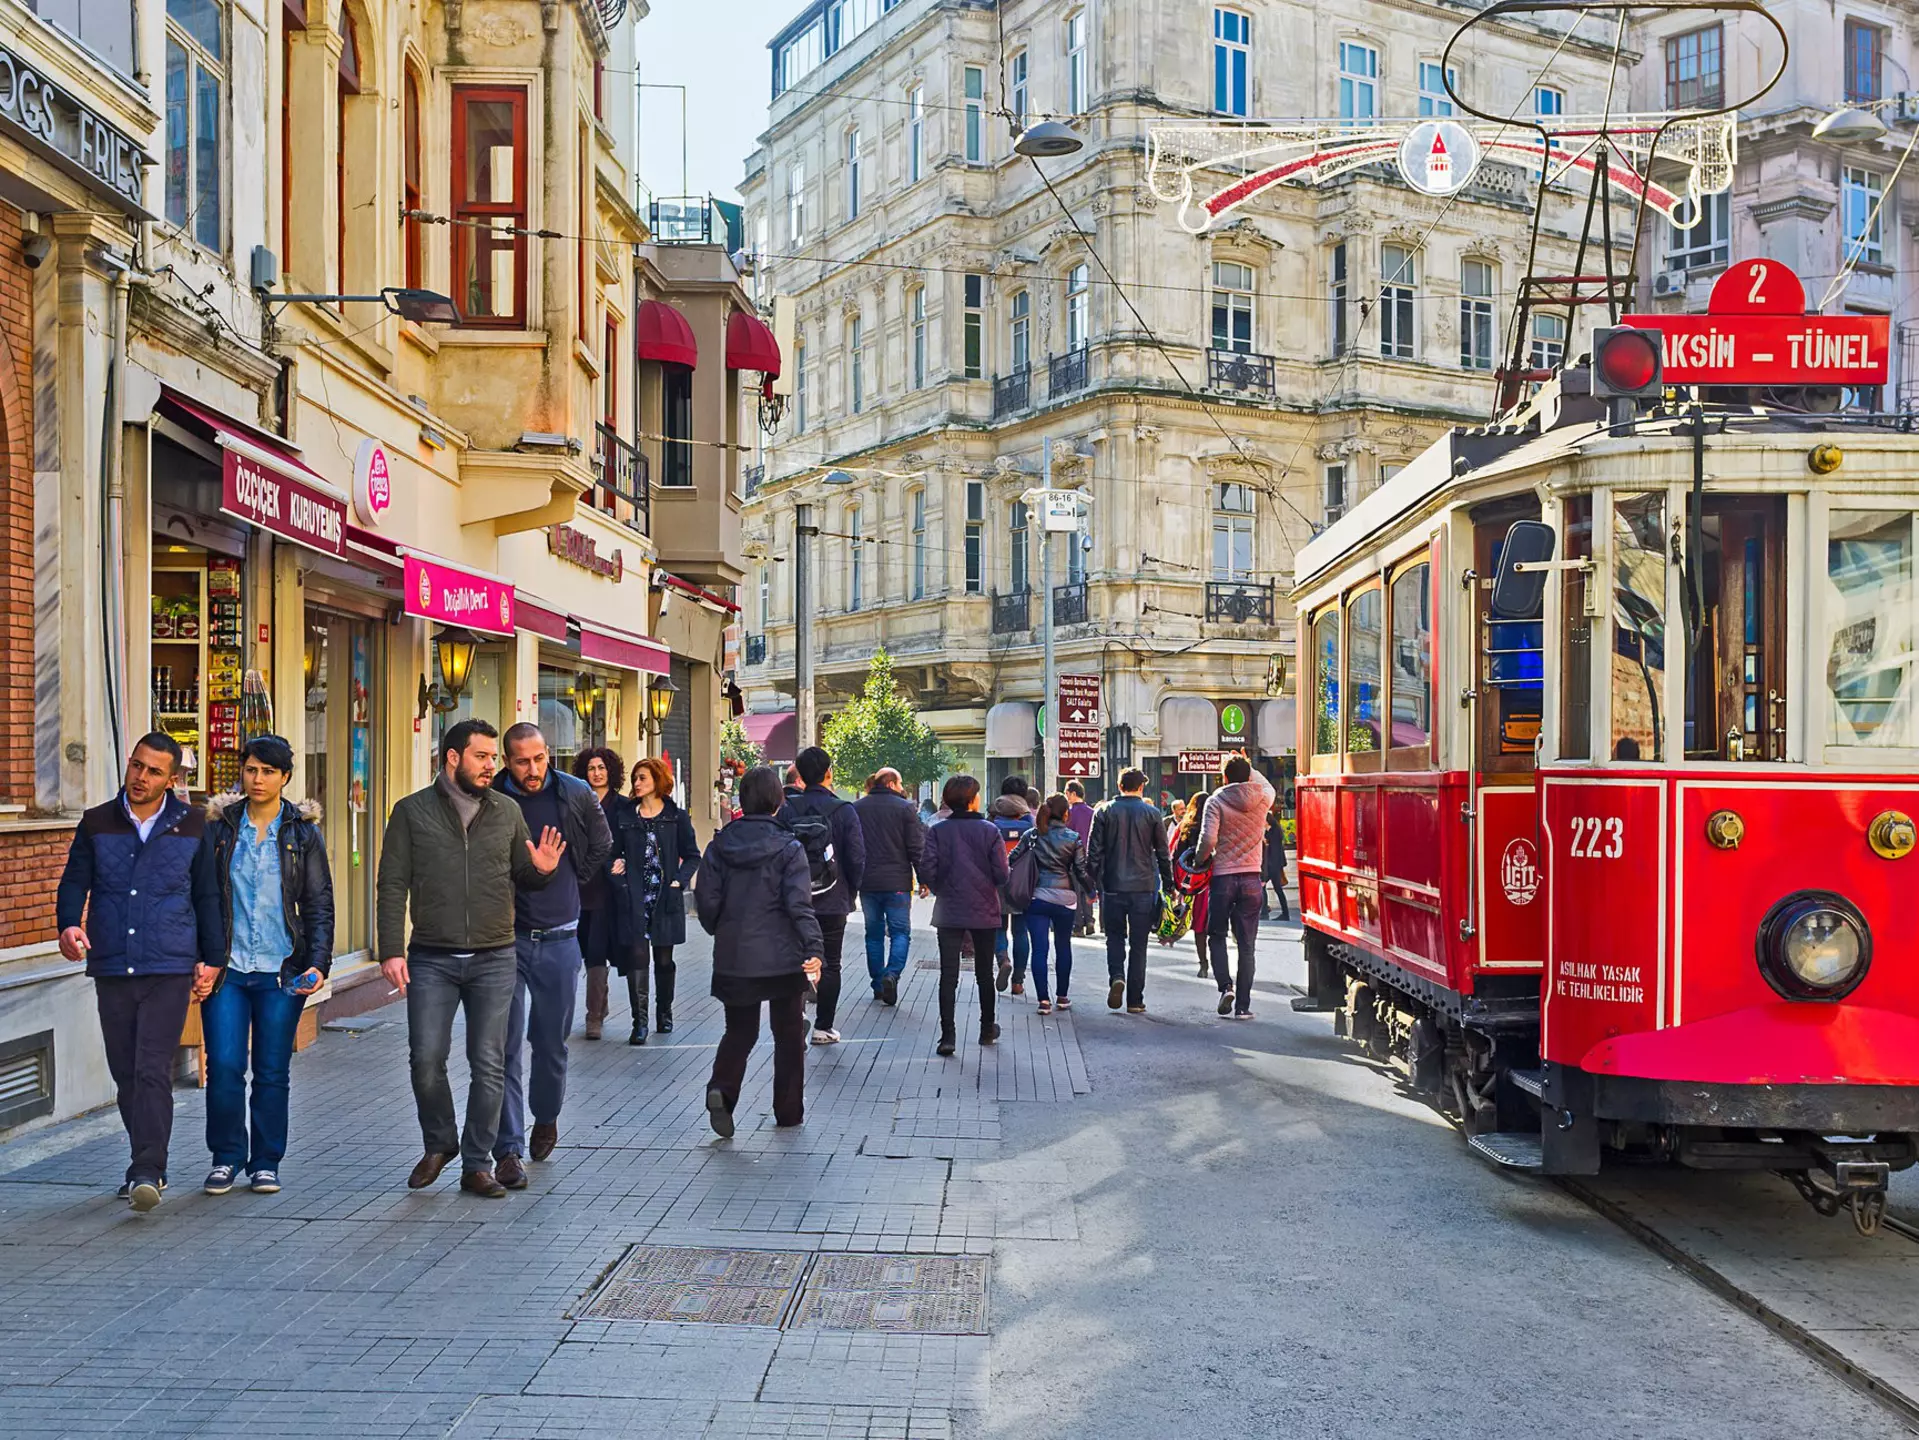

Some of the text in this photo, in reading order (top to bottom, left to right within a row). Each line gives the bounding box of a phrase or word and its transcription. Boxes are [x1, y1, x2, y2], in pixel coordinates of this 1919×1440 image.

[79, 109, 142, 206] FRIES
[1748, 264, 1767, 303] 2
[1661, 327, 1735, 368] AKSİM
[1786, 328, 1879, 369] TÜNEL
[236, 455, 342, 554] ÖZÇİÇEK KURUYEMİŞ
[1570, 816, 1624, 859] 223
[1557, 979, 1644, 1004] VE TEHLİKELİDİR
[1602, 964, 1641, 983] YASAK
